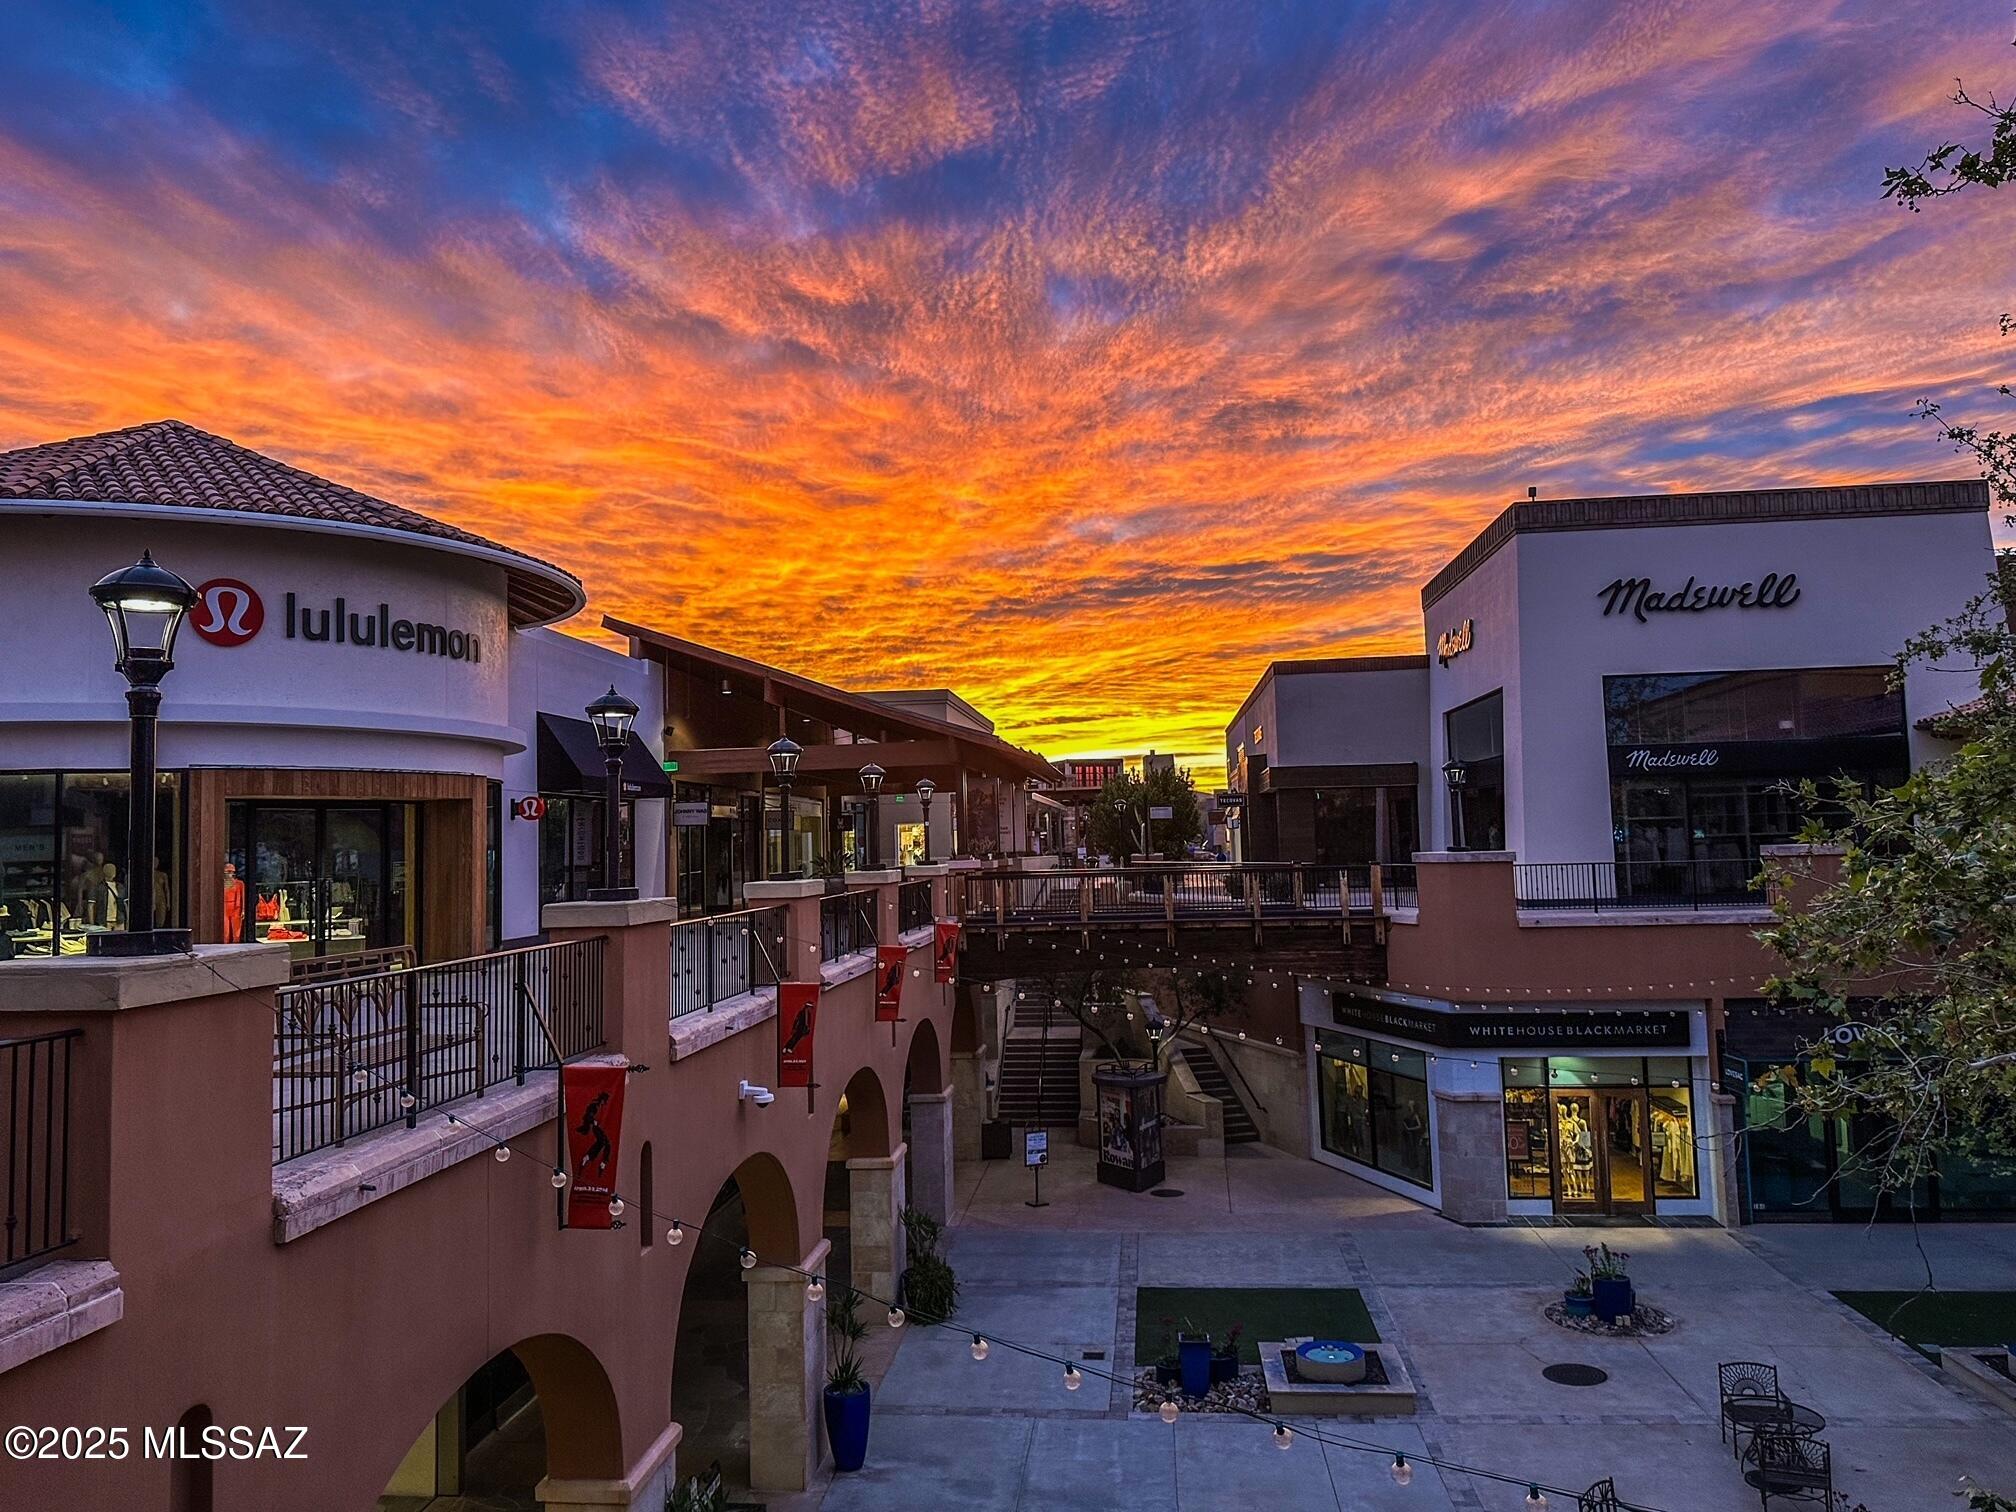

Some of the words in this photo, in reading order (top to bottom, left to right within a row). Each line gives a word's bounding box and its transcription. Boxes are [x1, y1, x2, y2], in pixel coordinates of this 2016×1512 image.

[1597, 573, 1801, 623] Madewell
[285, 592, 481, 663] lululemon
[1437, 618, 1473, 668] Madewell
[1626, 749, 1719, 771] Madewell
